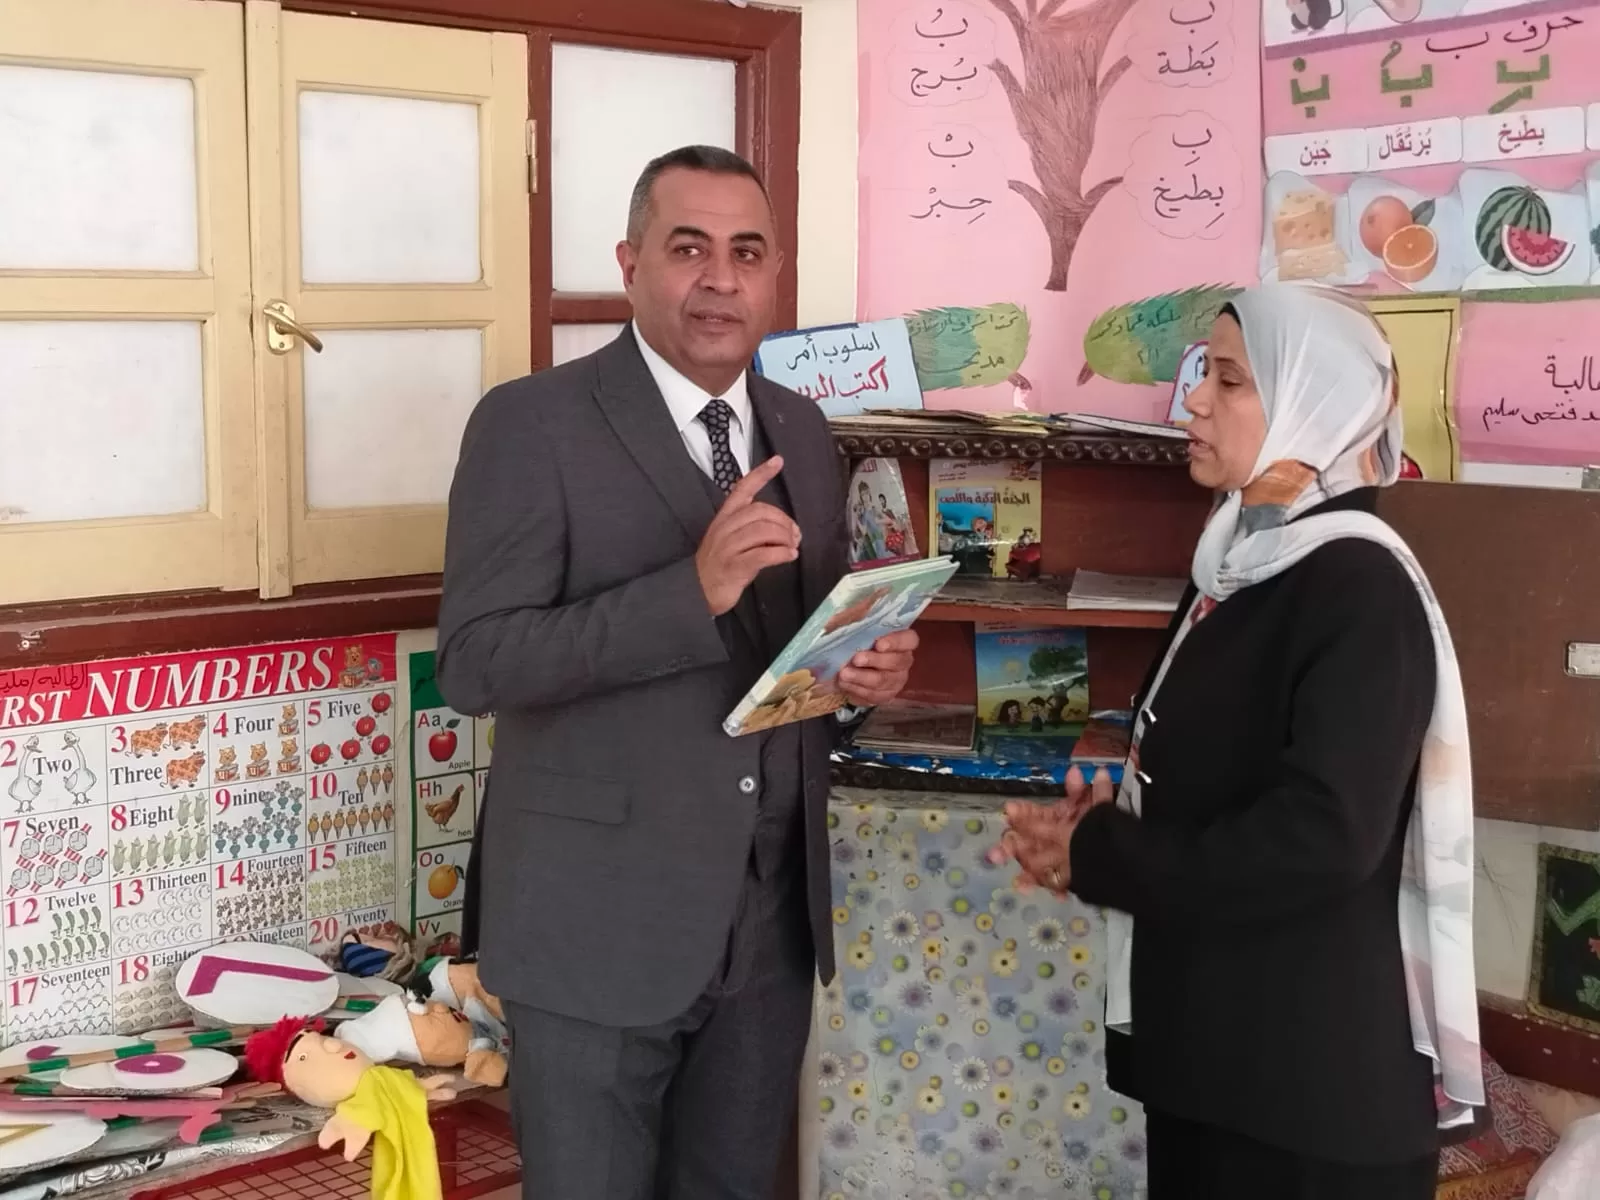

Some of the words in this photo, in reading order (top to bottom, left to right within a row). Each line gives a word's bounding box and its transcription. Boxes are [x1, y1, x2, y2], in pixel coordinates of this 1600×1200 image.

[1425, 31, 1489, 59] ب
[1503, 16, 1583, 53] حرف
[82, 646, 334, 718] NUMBERS
[212, 711, 229, 738] 4
[235, 716, 275, 735] Four
[307, 700, 322, 727] 5
[328, 701, 362, 719] Five
[418, 712, 441, 729] Aa
[0, 740, 18, 767] 2
[110, 726, 128, 753] 3
[33, 756, 73, 776] Two
[110, 766, 163, 786] Three
[448, 760, 471, 770] Apple
[308, 772, 338, 800] 10
[337, 790, 364, 807] Ten
[419, 781, 443, 799] Hh
[215, 788, 232, 815] 9
[232, 788, 266, 807] nine
[3, 820, 21, 848] 7
[25, 816, 80, 836] Seven
[110, 804, 127, 832] 8
[130, 804, 174, 828] Eight
[307, 845, 337, 873] 15
[345, 840, 387, 857] Fifteen
[215, 861, 245, 890] 14
[247, 854, 304, 873] Fourteen
[113, 879, 145, 910] 13
[147, 872, 207, 892] Thirteen
[5, 897, 41, 928] 12
[45, 892, 97, 912] Twelve
[249, 926, 304, 944] Nineteen
[308, 917, 339, 945] 20
[344, 908, 388, 927] Twenty
[117, 955, 149, 986] 18
[8, 976, 39, 1008] 17
[41, 965, 111, 989] Seventeen
